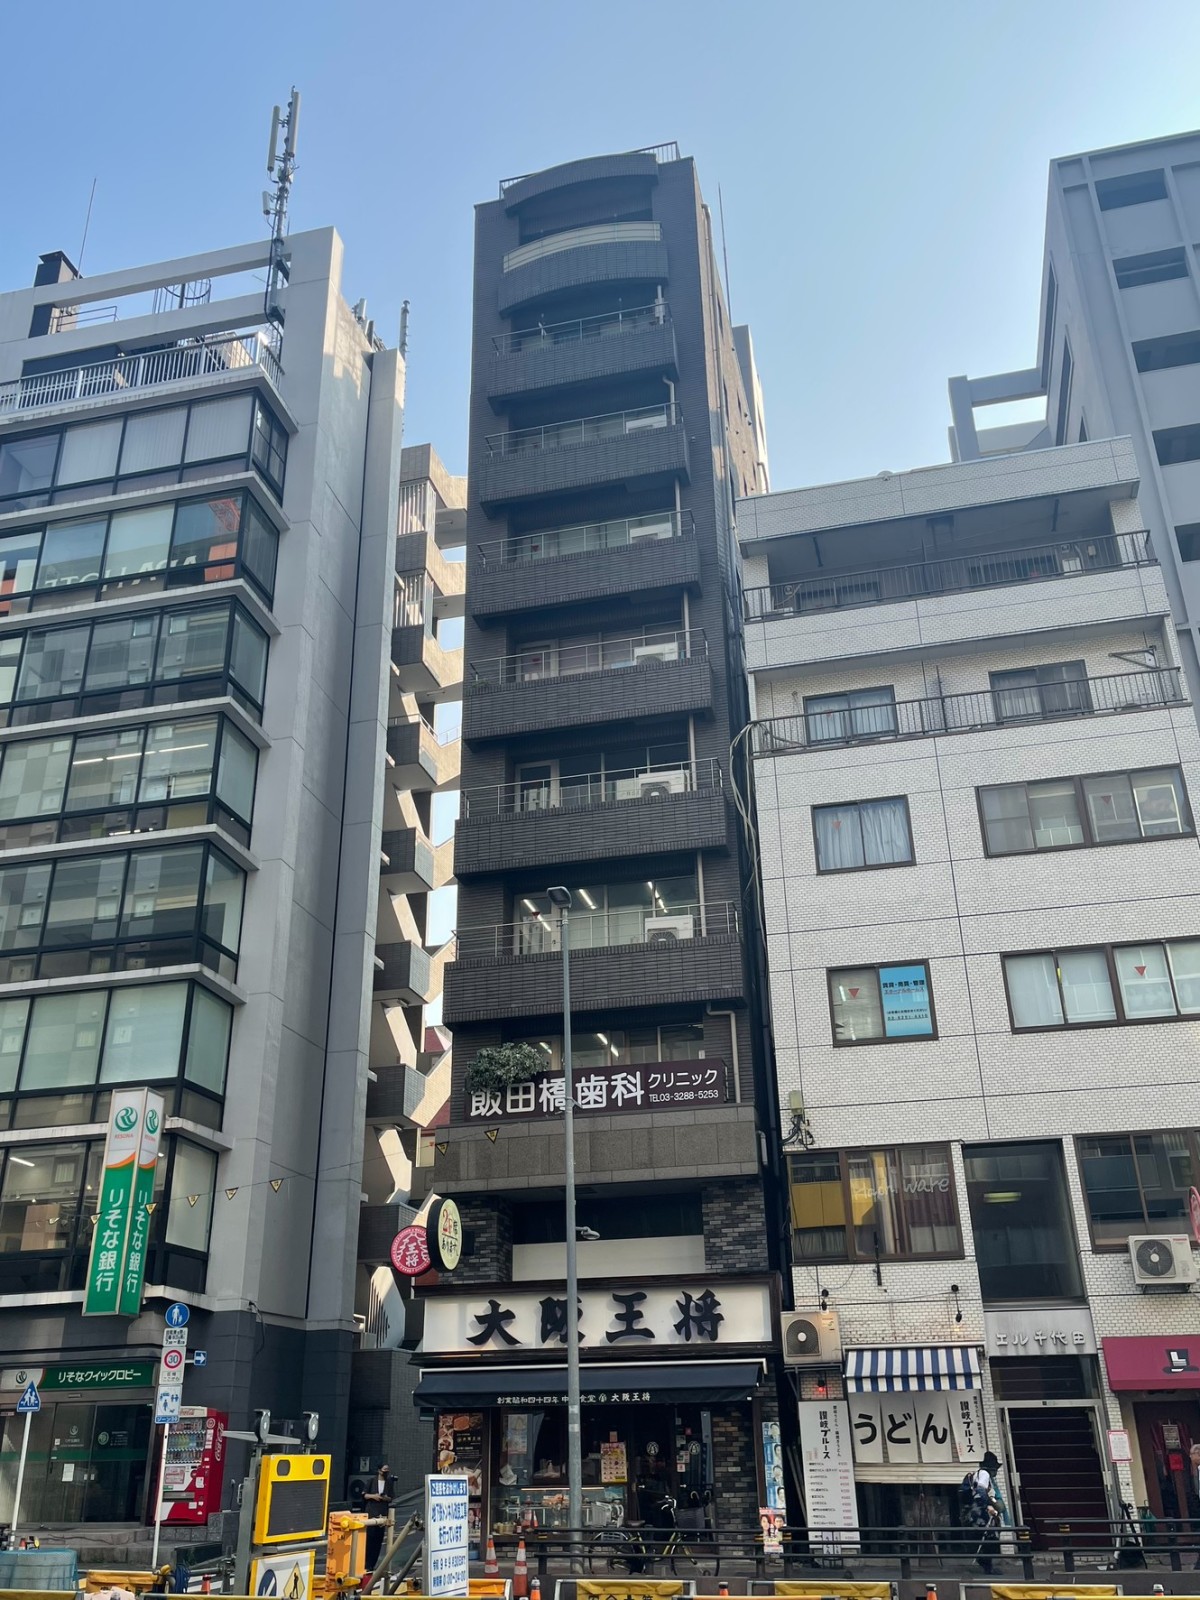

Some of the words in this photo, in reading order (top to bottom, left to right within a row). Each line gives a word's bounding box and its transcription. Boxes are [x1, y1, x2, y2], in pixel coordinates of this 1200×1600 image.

[648, 1069, 718, 1088] クリニック
[96, 1188, 124, 1292] りそな銀行
[126, 1190, 148, 1294] りそな銀行
[405, 1242, 419, 1267] 王将
[466, 1288, 725, 1346] 大阪王将
[996, 1330, 1086, 1346] エル千代田
[167, 1354, 179, 1364] 30
[58, 1369, 142, 1383] りそなクイックロビー
[611, 1391, 651, 1402] 大阪王将
[854, 1412, 948, 1446] うどん
